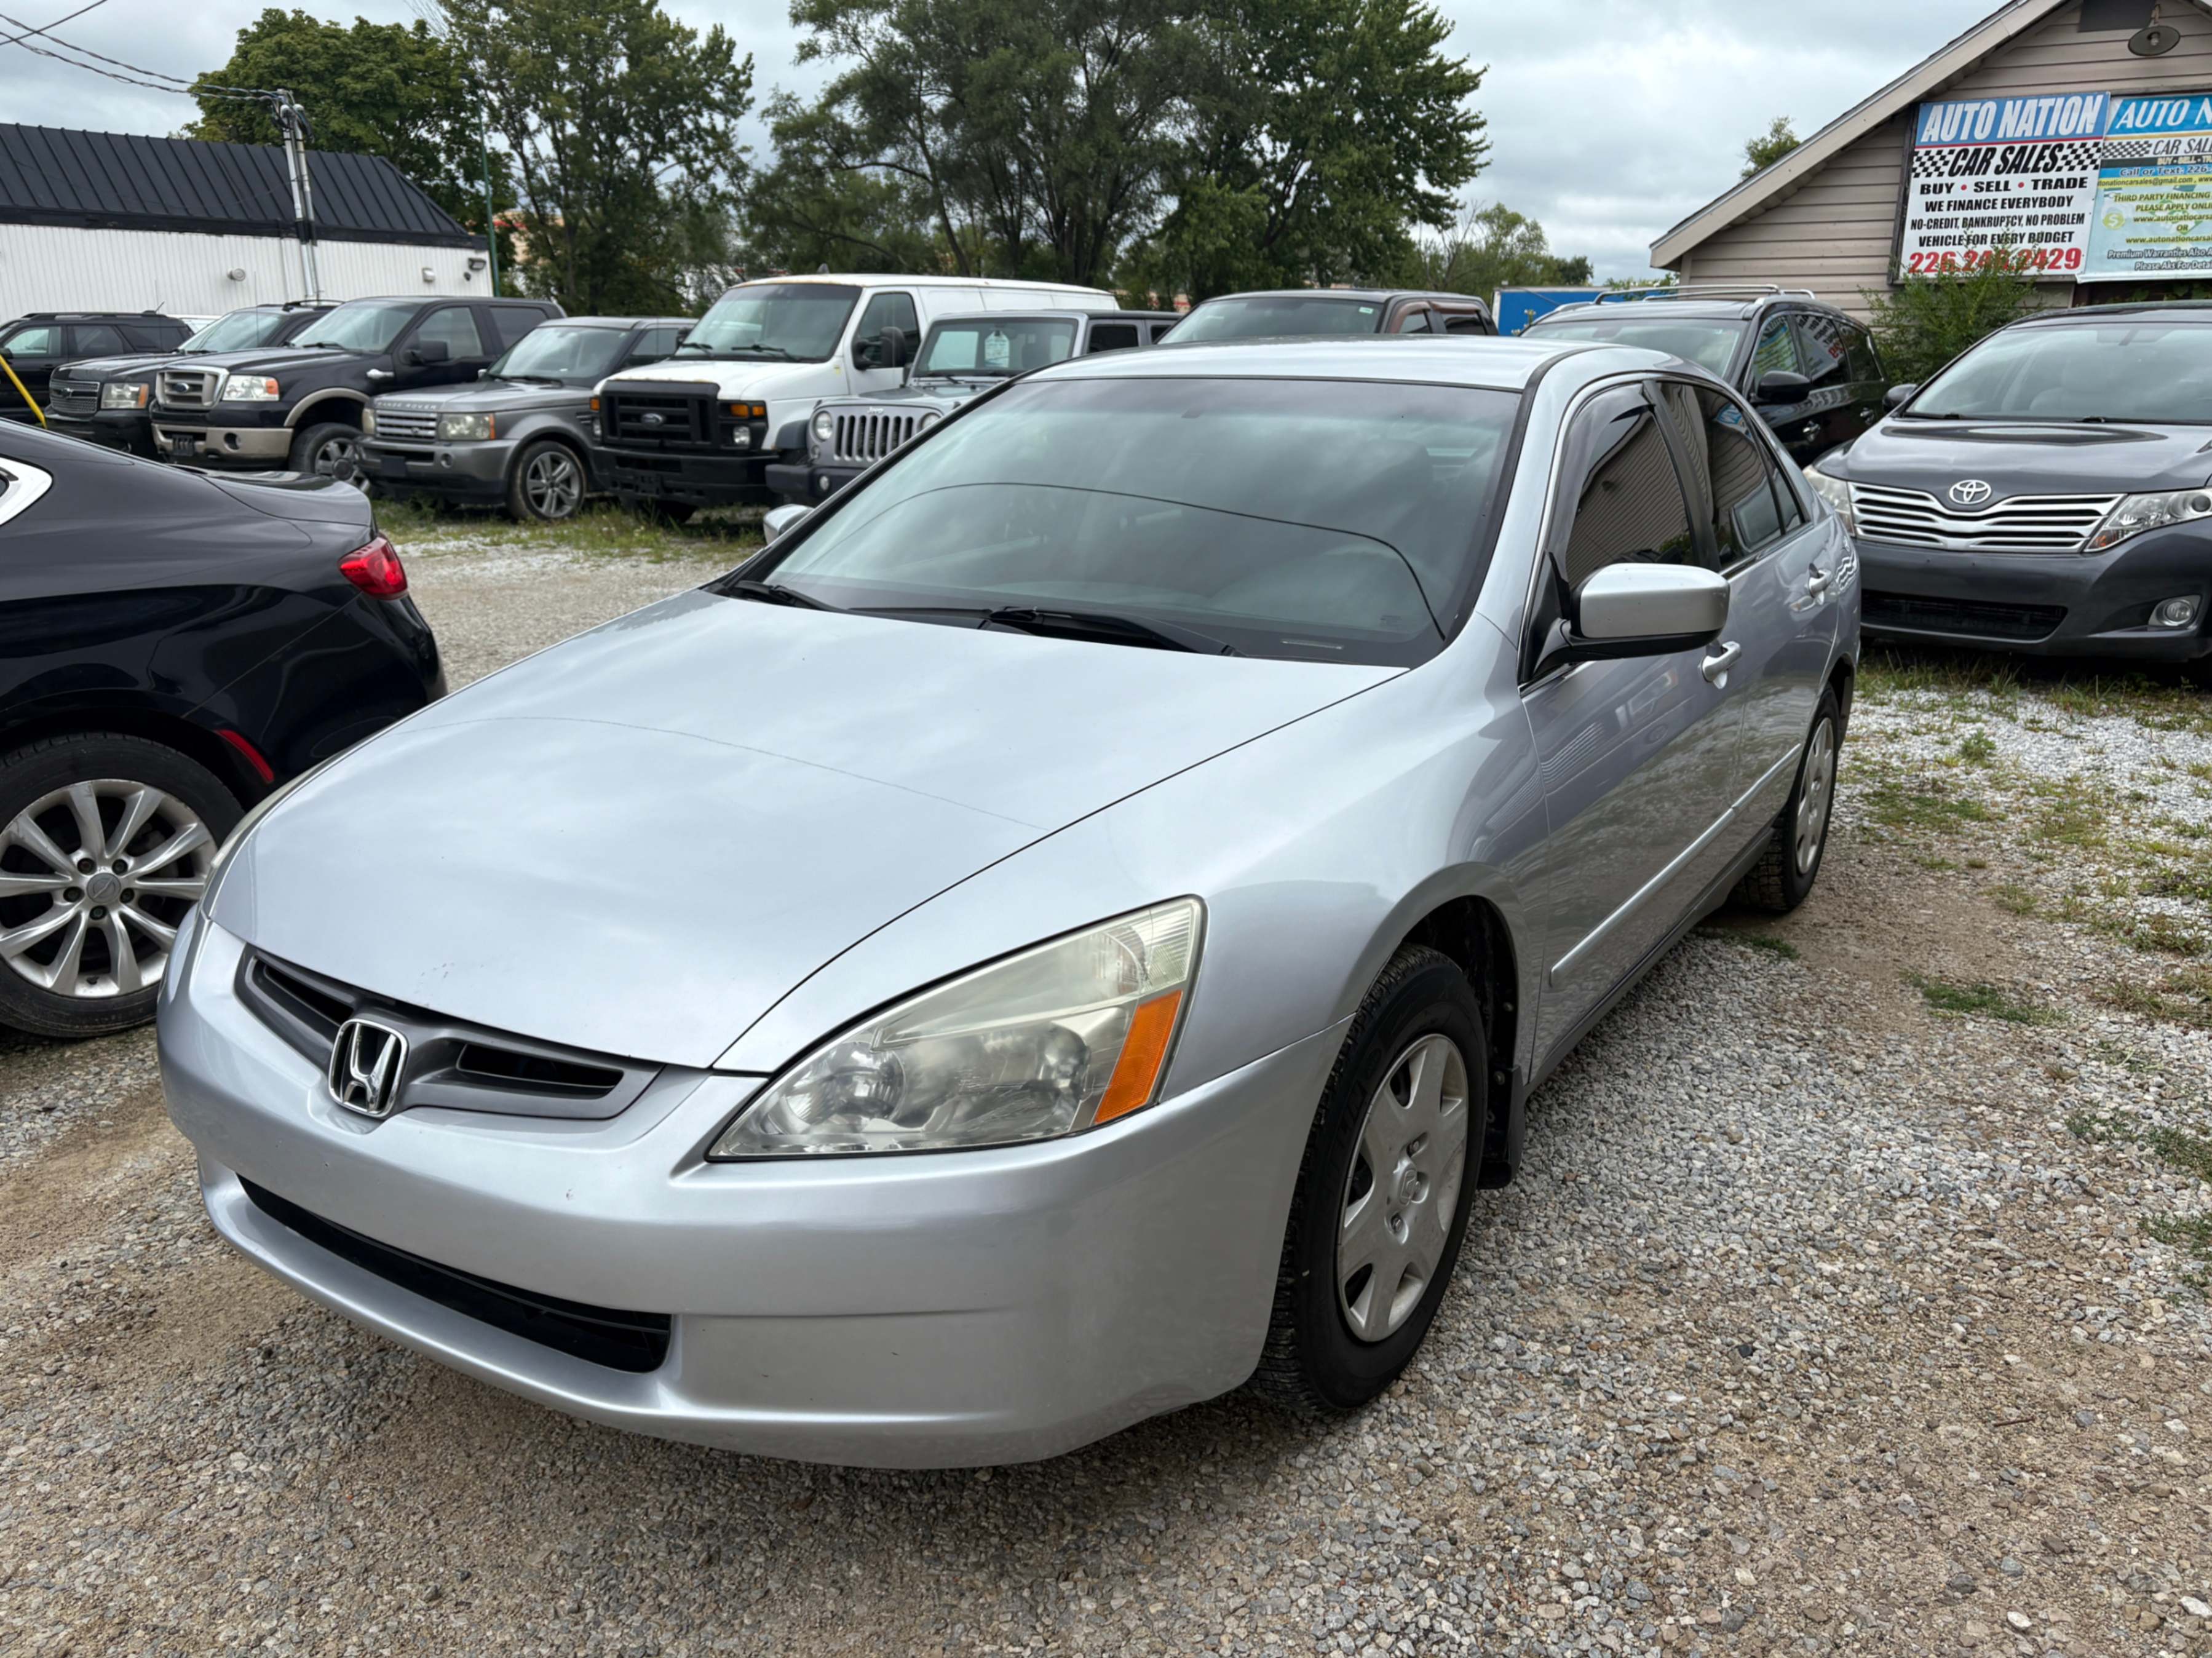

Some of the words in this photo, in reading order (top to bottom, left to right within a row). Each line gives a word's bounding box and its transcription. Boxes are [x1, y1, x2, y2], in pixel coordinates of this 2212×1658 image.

[1921, 101, 1997, 142] AUTO
[1997, 95, 2104, 139] NATION
[2115, 99, 2190, 129] AUTO
[2152, 139, 2182, 155] CAR
[1948, 146, 1997, 177] CAR
[1994, 143, 2064, 175] SALES
[2120, 167, 2140, 177] Call
[1920, 183, 1954, 195] BUY
[1973, 180, 2011, 193] SELL
[2031, 177, 2088, 190] TRADE
[1925, 200, 1944, 212] WE
[1946, 198, 1998, 212] FINANCE
[2000, 196, 2074, 209] EVERYBODY
[2114, 194, 2137, 202] THIRD
[2166, 191, 2210, 200] FINANCING
[2135, 204, 2163, 212] PLEASE
[1911, 217, 1960, 231] NO-CREDIT,
[1962, 215, 2024, 229] BANKRUPTCY,
[2026, 215, 2039, 226] NO
[2040, 213, 2085, 226] PROBLEM
[1919, 234, 1964, 247] VEHICLE
[1967, 234, 1988, 245] FOR
[2028, 231, 2075, 244] BUDGET
[2107, 249, 2143, 259] Premium
[2144, 247, 2187, 258] Warranties
[2187, 247, 2206, 257] Also
[2135, 261, 2162, 271] Please
[2177, 261, 2190, 270] For
